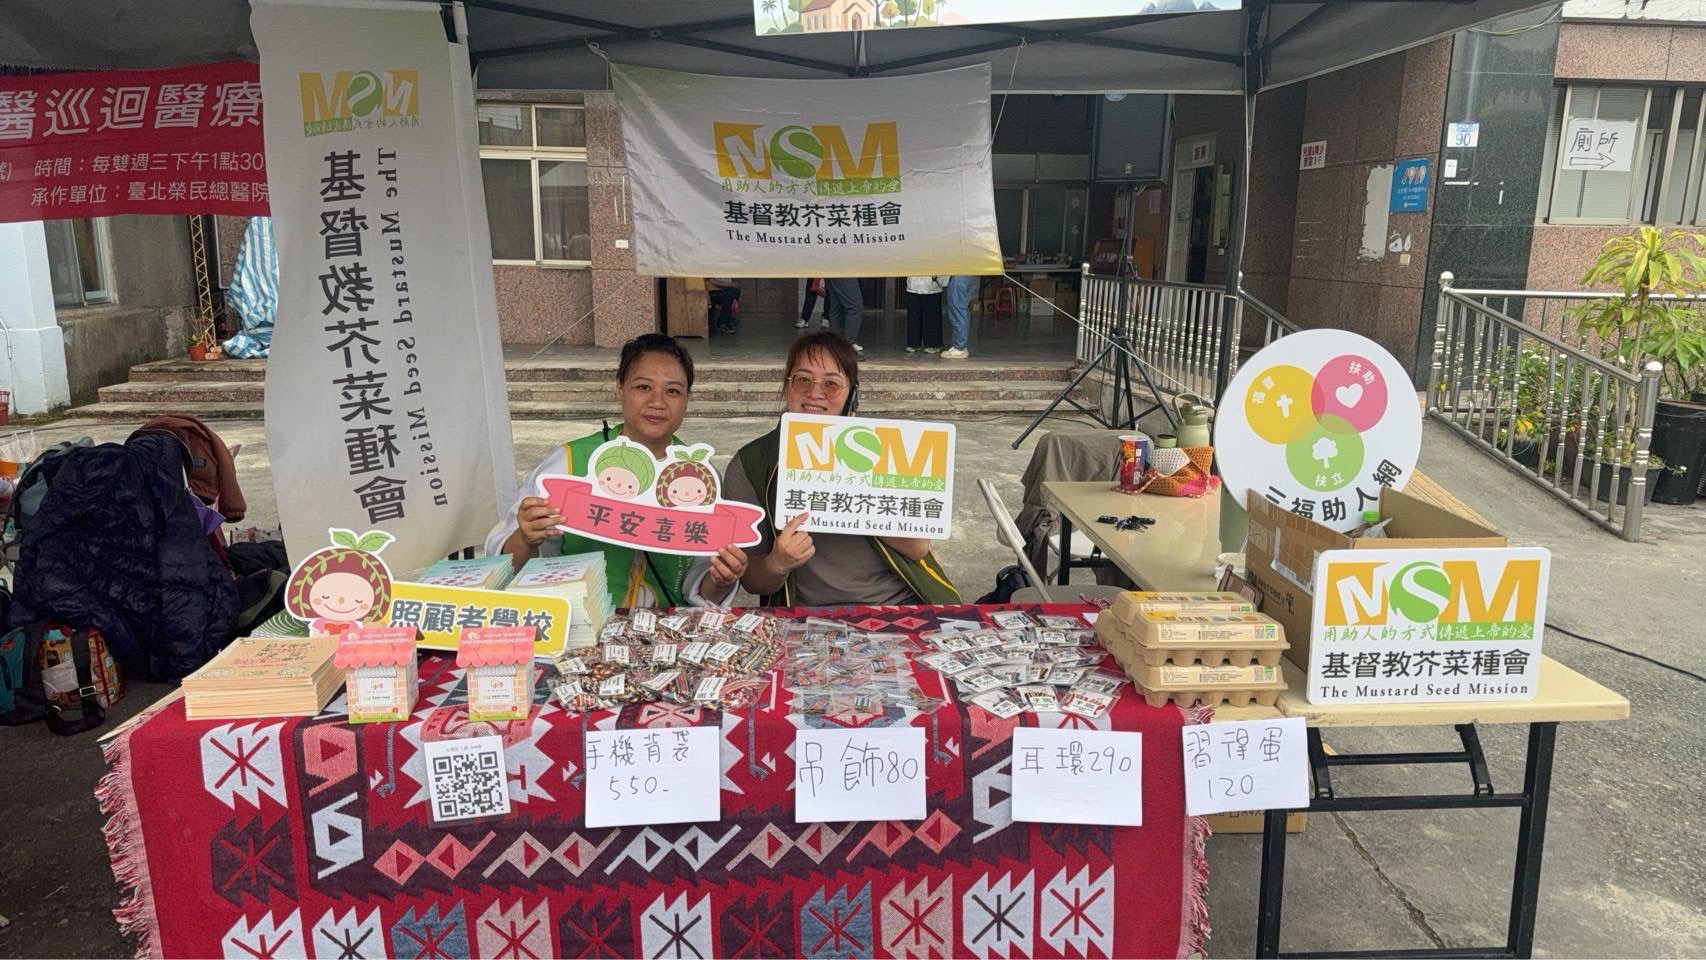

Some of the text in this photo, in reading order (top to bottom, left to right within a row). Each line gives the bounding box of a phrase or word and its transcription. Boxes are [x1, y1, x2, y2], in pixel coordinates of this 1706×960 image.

[0, 81, 263, 140] 醫巡迴醫療
[713, 121, 901, 180] NSM
[1455, 132, 1472, 146] 90
[1569, 127, 1619, 153] 廁所
[723, 200, 902, 227] 基督教芥菜種會
[726, 229, 906, 245] The Mustard Seed Mission
[786, 420, 949, 478] NSM
[784, 489, 945, 519] 基督教芥菜種會
[1265, 458, 1402, 521] 三福助人網
[587, 503, 710, 544] 平安喜樂
[811, 518, 860, 530] Mustard
[865, 520, 892, 531] Seed
[897, 522, 944, 534] Mission
[1323, 559, 1541, 626] NSM
[390, 599, 553, 642] 照顧者學校
[1321, 648, 1531, 679] 基督教芥菜種會
[1320, 683, 1528, 698] The Mustard Seed Mission
[586, 730, 690, 770] 手機背袋
[799, 736, 919, 798] 吊飾80
[1018, 740, 1132, 776] 耳環290
[1208, 774, 1254, 799] 120
